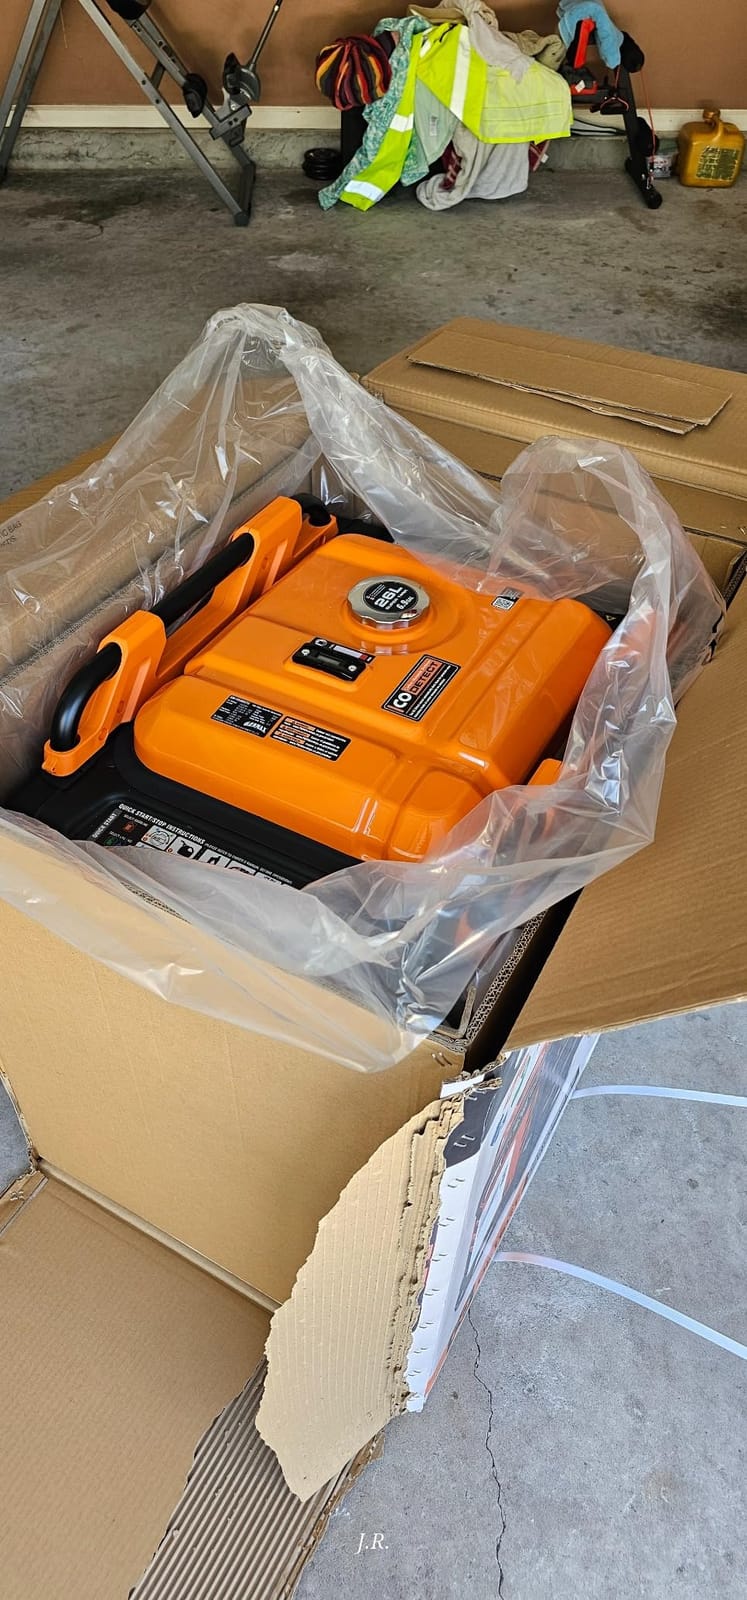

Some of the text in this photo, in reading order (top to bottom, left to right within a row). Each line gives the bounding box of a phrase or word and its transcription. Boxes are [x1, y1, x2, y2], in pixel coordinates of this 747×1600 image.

[374, 586, 403, 608] 26L
[409, 661, 438, 693] DETECT
[393, 692, 412, 708] CO
[103, 813, 117, 825] START
[118, 803, 136, 814] QUICK
[166, 823, 206, 844] INSTRUCTIONS
